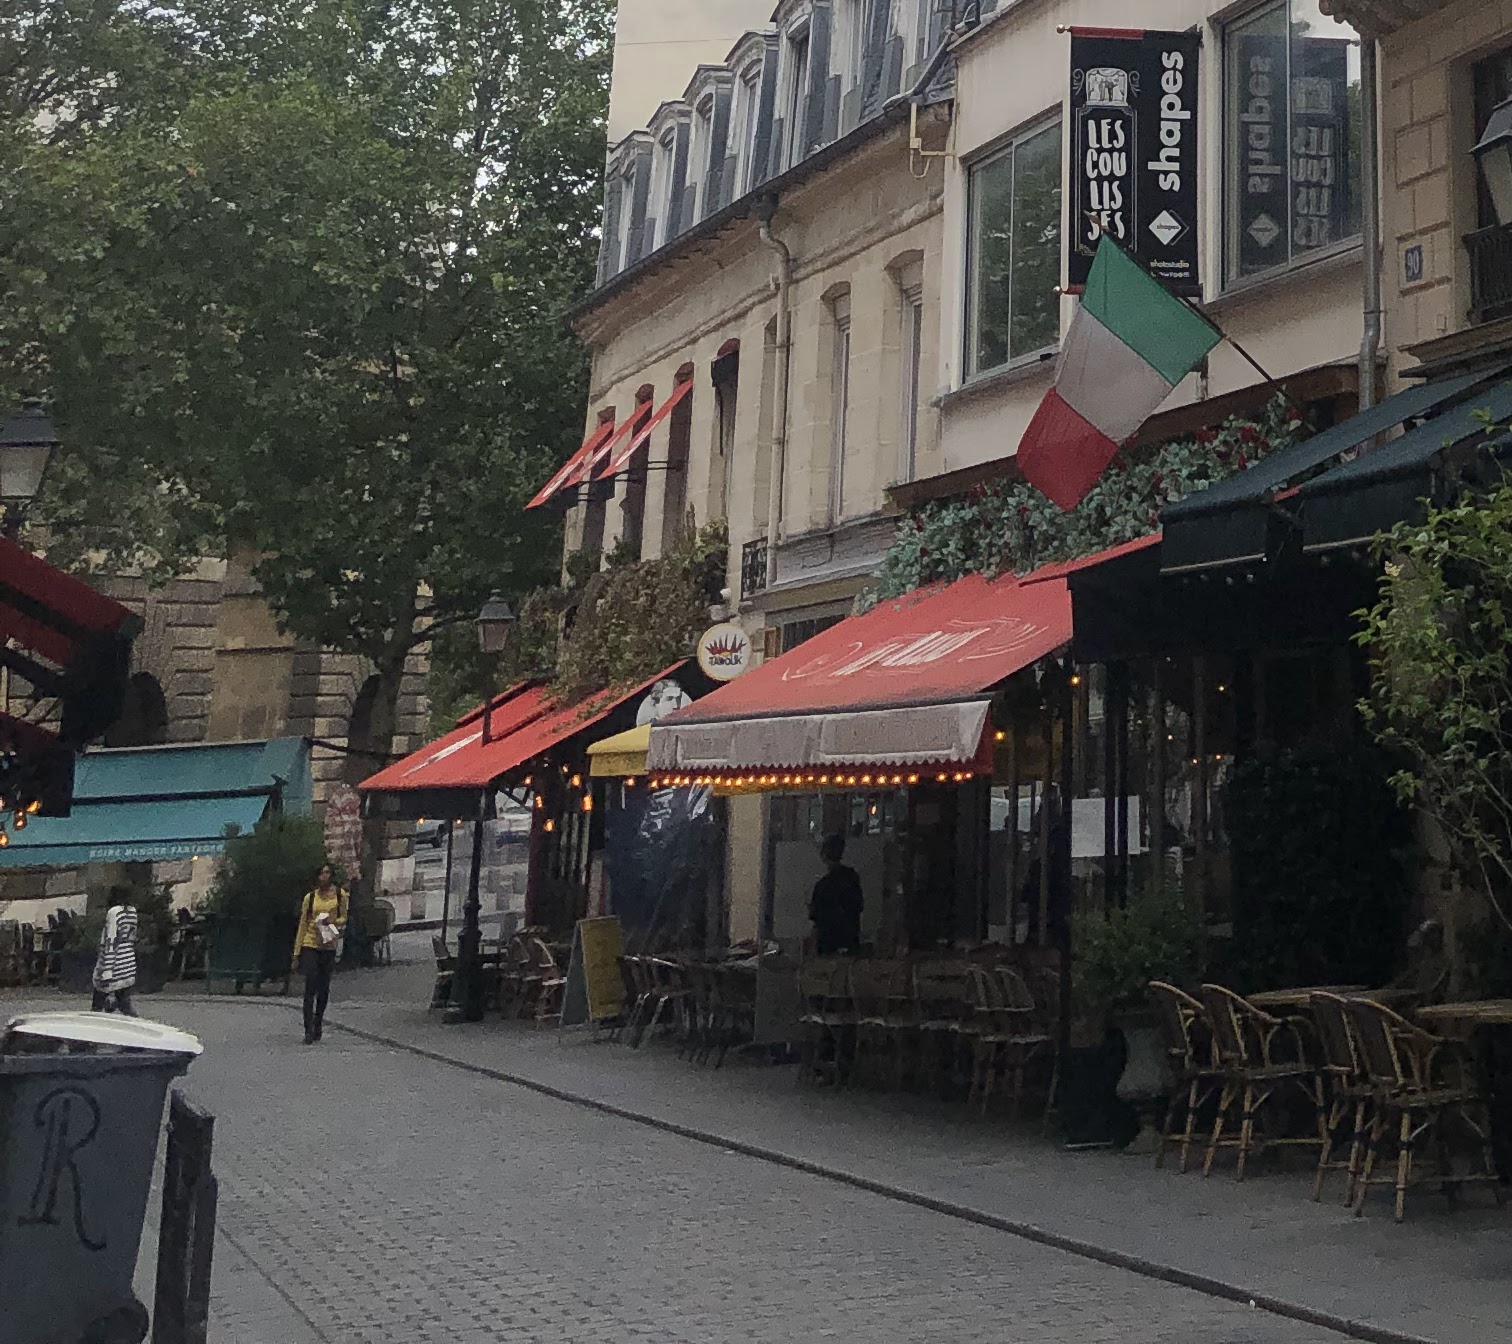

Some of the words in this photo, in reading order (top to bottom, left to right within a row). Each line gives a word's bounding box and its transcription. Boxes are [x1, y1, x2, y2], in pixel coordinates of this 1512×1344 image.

[1087, 118, 1126, 150] LES
[1147, 50, 1191, 193] shapes
[1085, 147, 1128, 179] COU
[1089, 179, 1124, 210] LIS
[1407, 249, 1420, 277] 90
